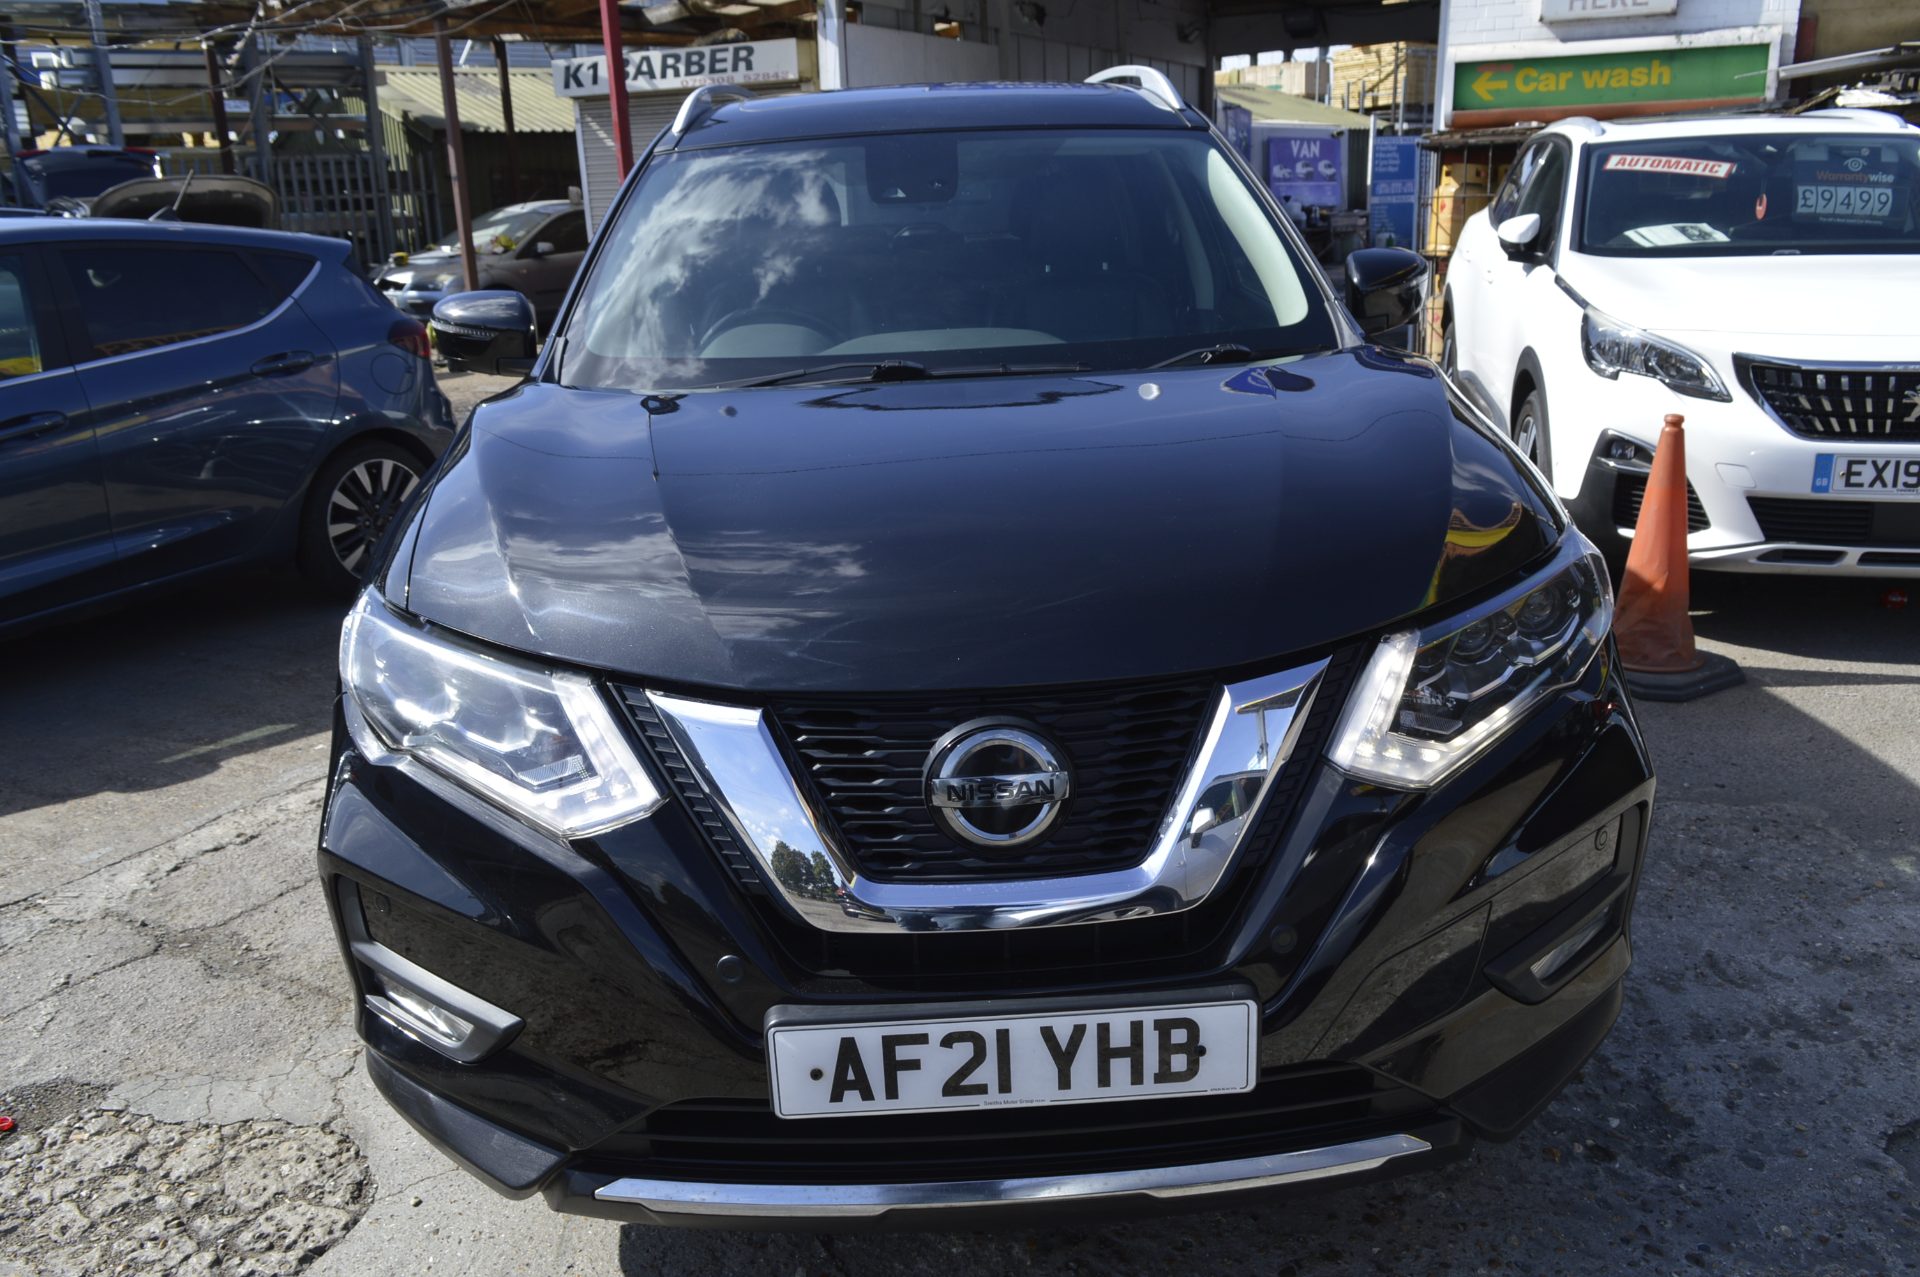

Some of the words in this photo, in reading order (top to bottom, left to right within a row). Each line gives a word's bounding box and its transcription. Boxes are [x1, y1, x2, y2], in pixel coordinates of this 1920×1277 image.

[563, 61, 599, 90] K1
[1515, 67, 1573, 93] Car
[1582, 59, 1671, 89] wash
[1290, 139, 1320, 158] VAN
[1614, 156, 1723, 174] AUTOMATIC
[1816, 171, 1895, 183] Warrantywise
[1800, 188, 1890, 212] £9499
[1844, 459, 1920, 489] EX19
[946, 778, 1055, 802] NISSAN
[828, 1028, 1012, 1104] AF21
[1039, 1016, 1201, 1091] YHB
